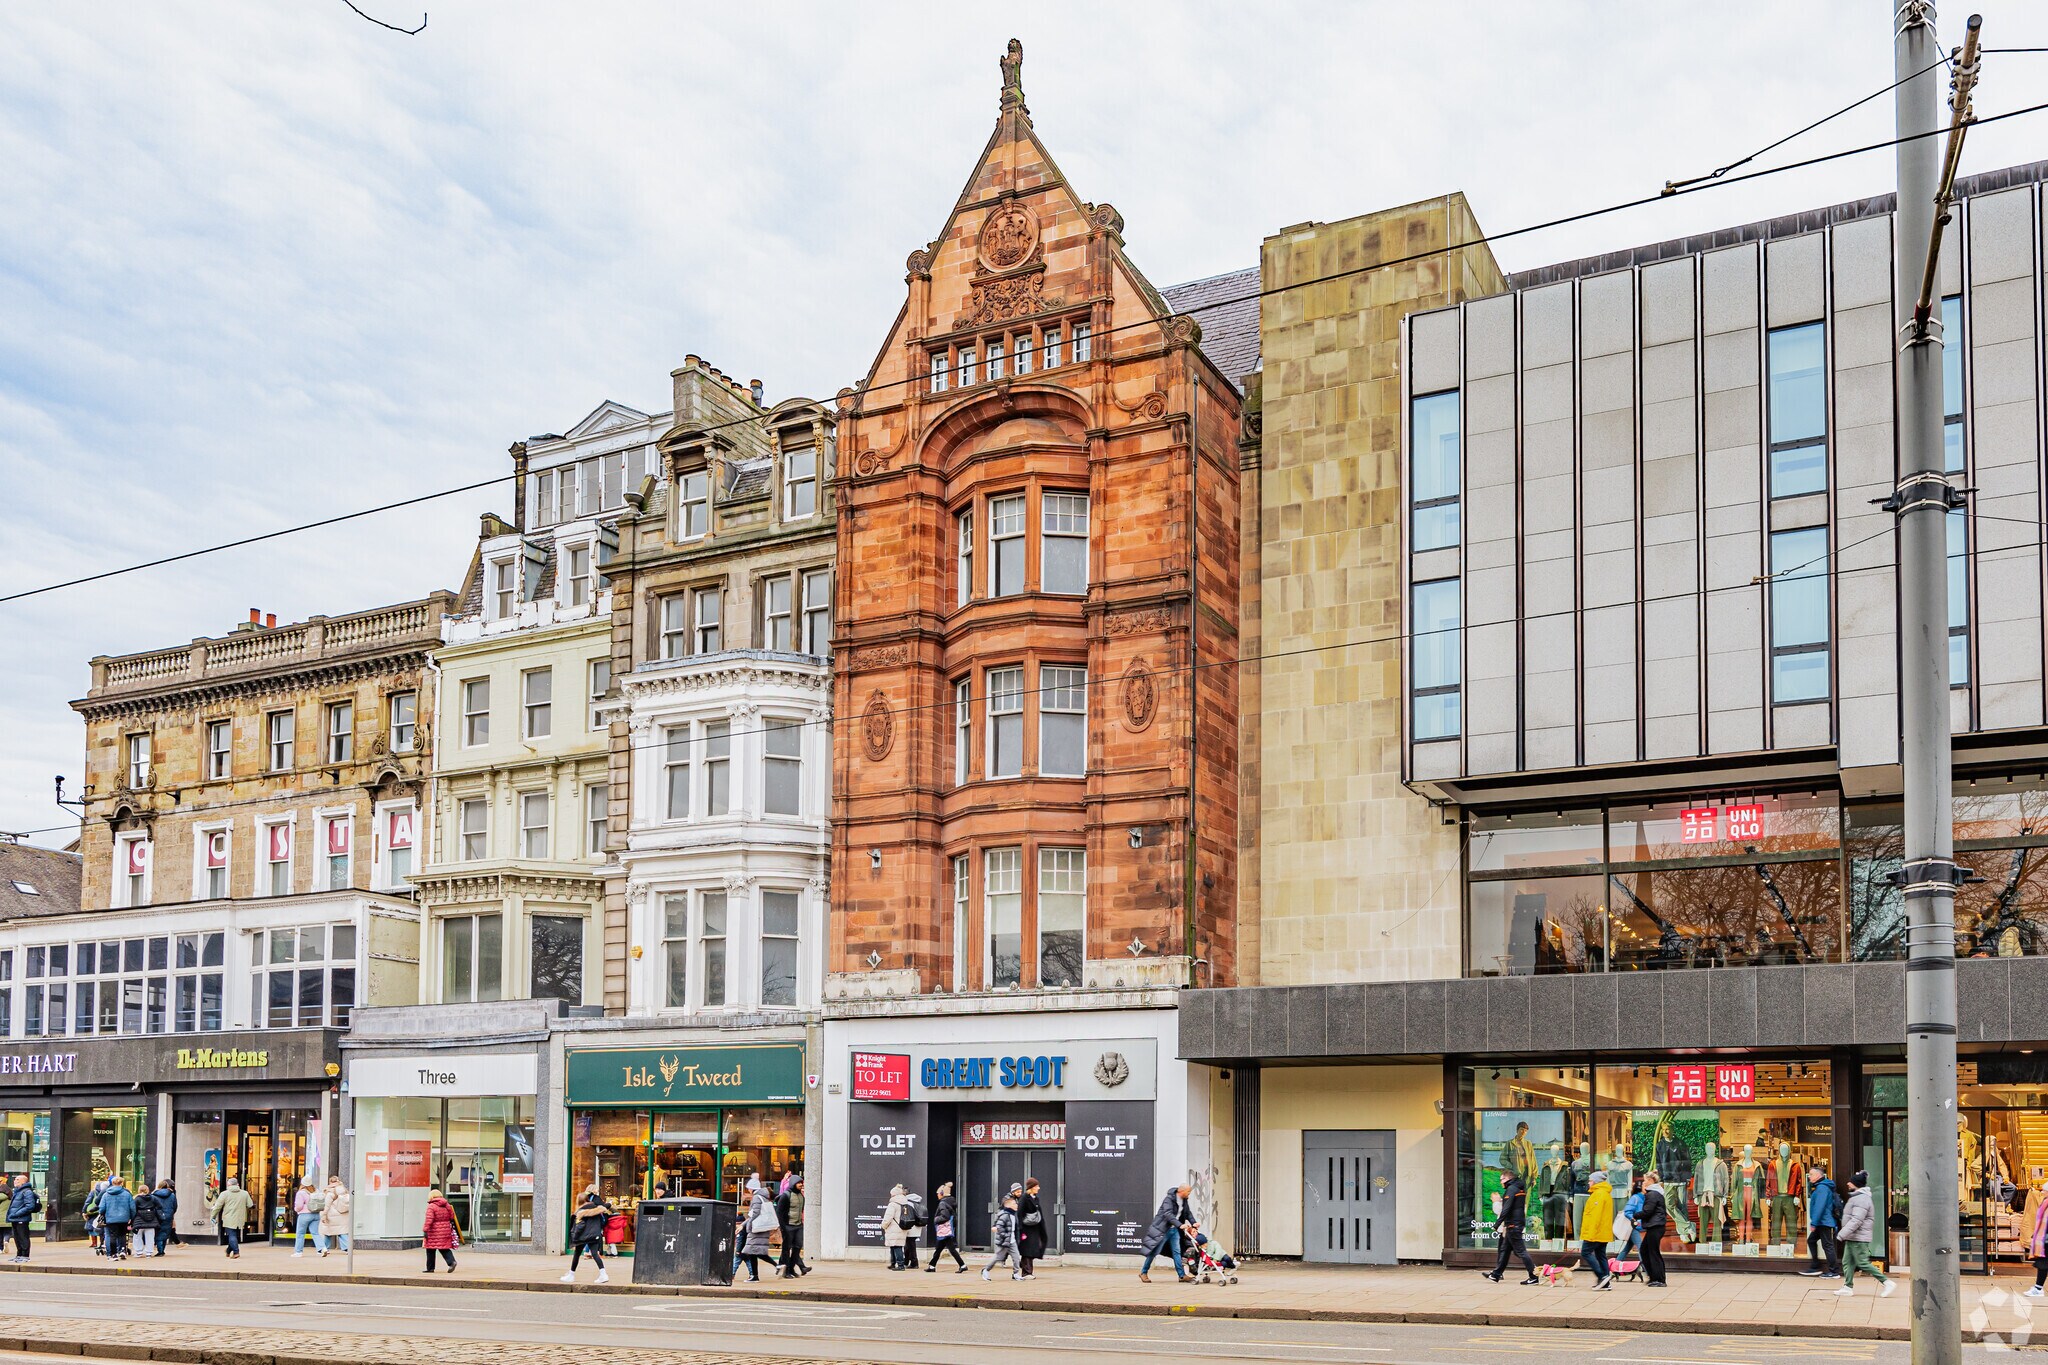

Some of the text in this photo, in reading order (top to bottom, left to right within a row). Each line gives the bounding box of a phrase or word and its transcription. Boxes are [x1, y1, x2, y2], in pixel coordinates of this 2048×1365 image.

[1730, 809, 1757, 822] UNI
[1730, 823, 1759, 838] QLO
[27, 1054, 77, 1073] HART
[418, 1069, 456, 1085] Three
[856, 1070, 902, 1083] TO LET
[921, 1056, 1068, 1088] GREAT SCOT
[1720, 1070, 1748, 1083] UNI
[623, 1064, 742, 1097] Isle of Tweed
[1720, 1085, 1750, 1100] QLO
[991, 1123, 1066, 1140] GREAT SCOT
[860, 1134, 916, 1148] TO LET
[1074, 1135, 1138, 1150] TO LET
[1471, 1230, 1539, 1242] from Coagen
